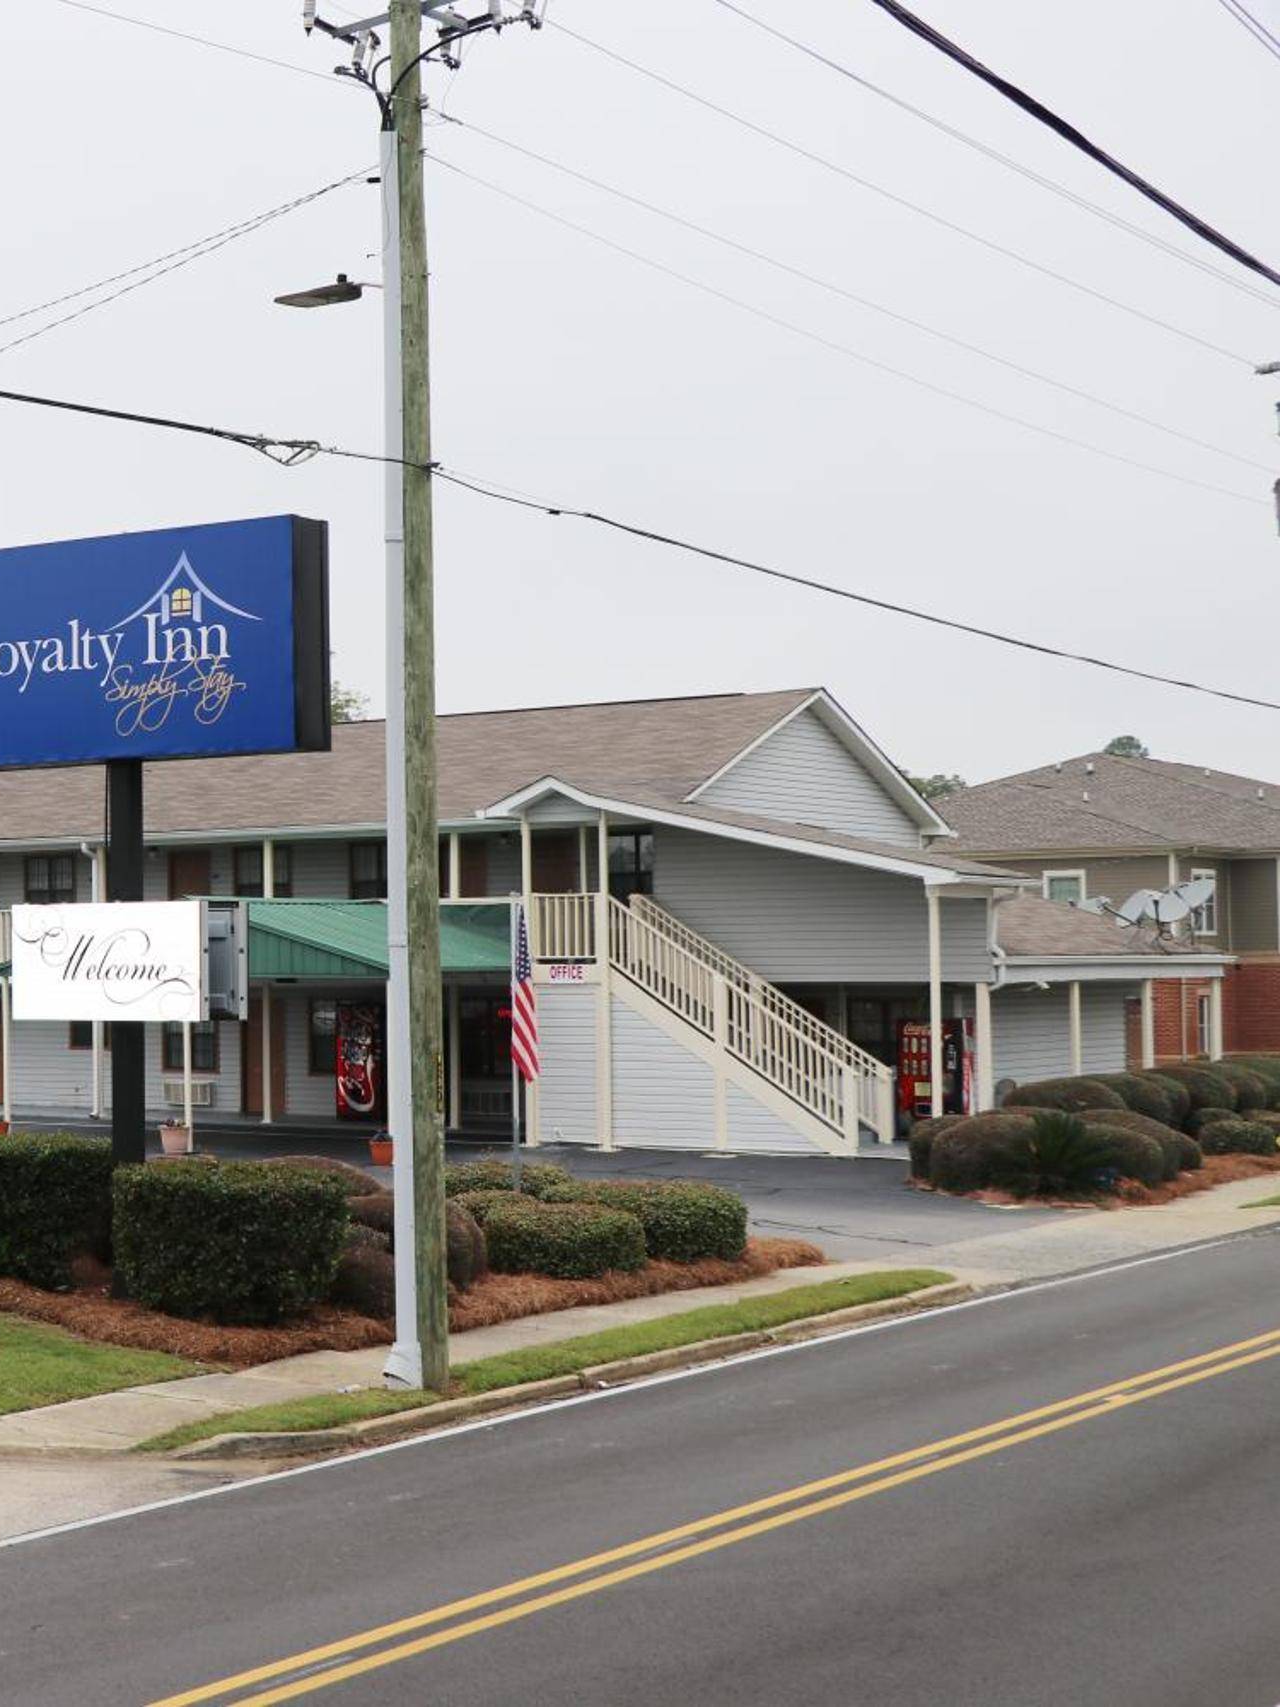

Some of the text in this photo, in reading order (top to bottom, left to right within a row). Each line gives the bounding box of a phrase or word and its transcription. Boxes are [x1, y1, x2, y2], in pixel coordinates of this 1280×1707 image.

[142, 612, 232, 665] Inn
[105, 643, 246, 736] Simply Stay
[38, 925, 195, 1005] Welcome
[549, 965, 584, 980] OFFICE
